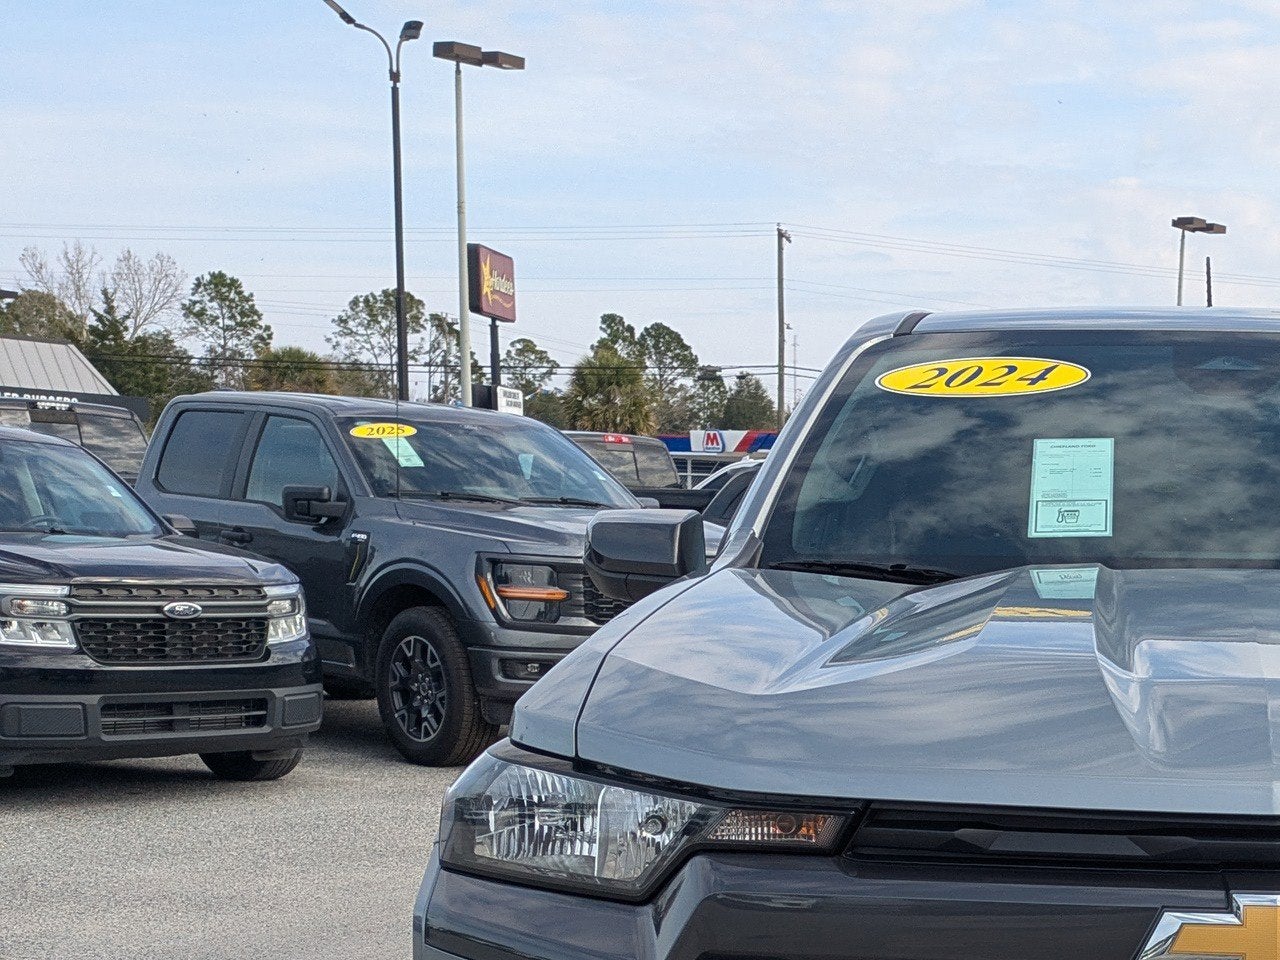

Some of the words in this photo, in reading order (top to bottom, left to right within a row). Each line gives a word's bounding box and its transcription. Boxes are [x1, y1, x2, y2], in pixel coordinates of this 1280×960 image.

[905, 364, 1061, 390] 2024
[366, 426, 405, 436] 2025
[705, 432, 719, 446] M
